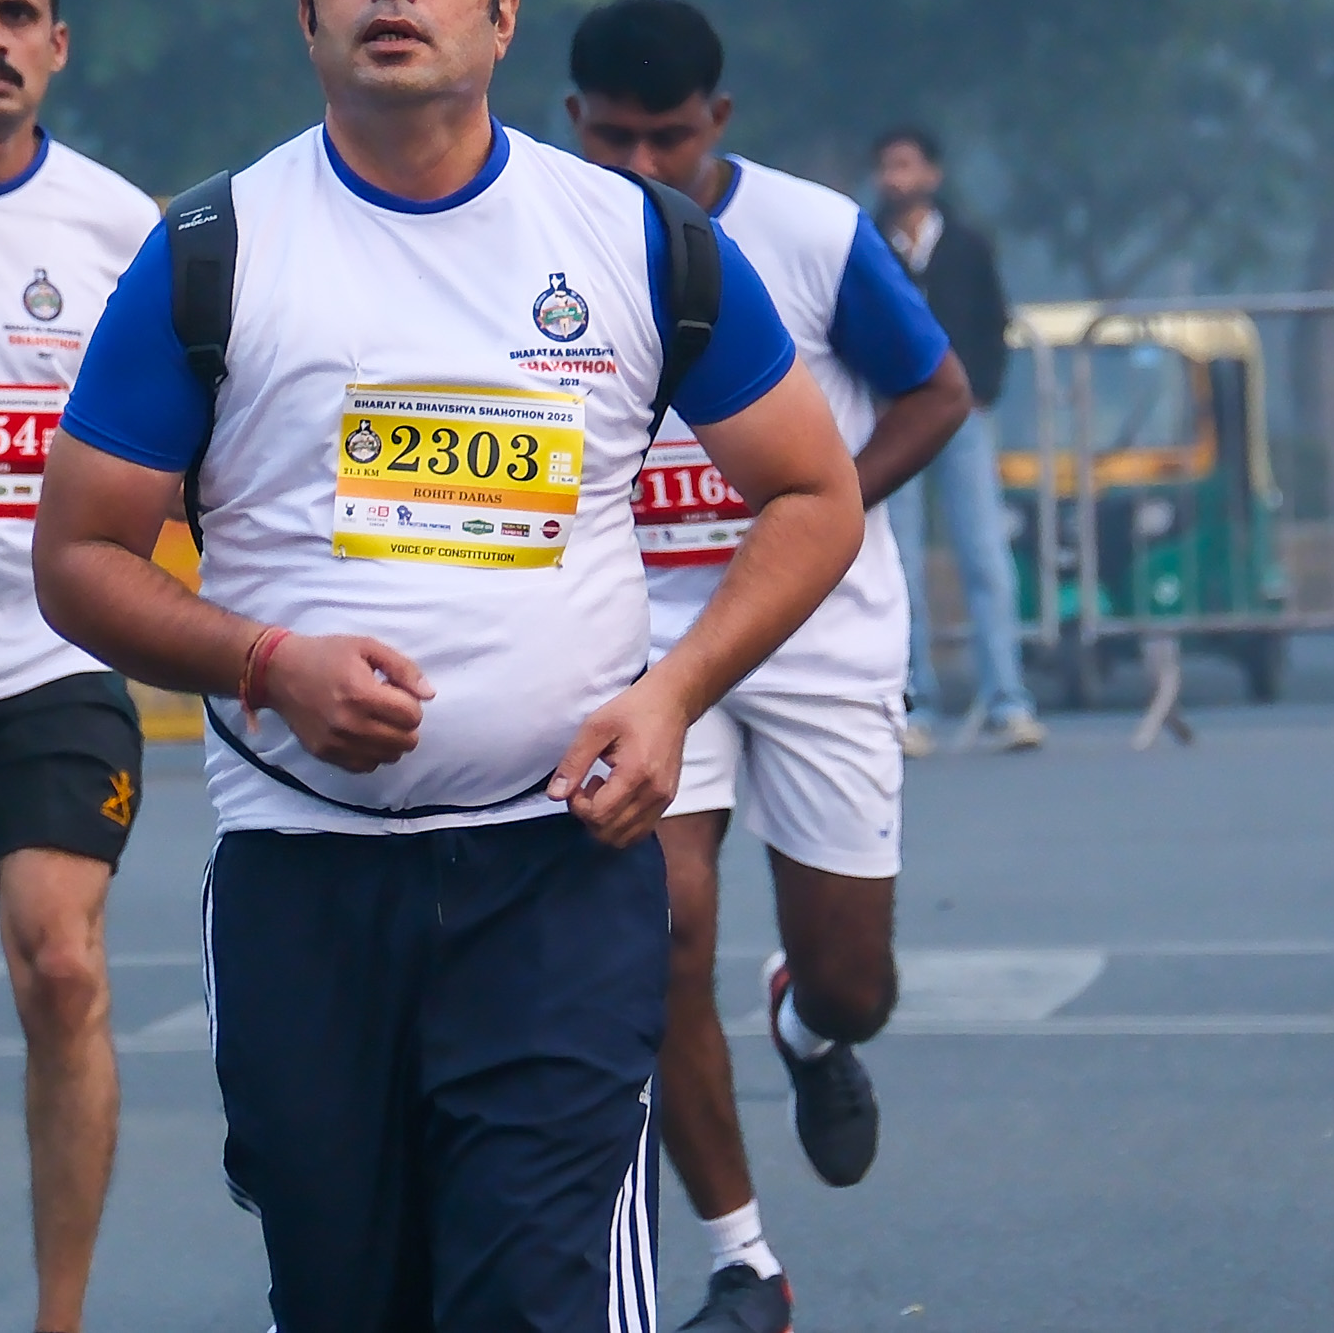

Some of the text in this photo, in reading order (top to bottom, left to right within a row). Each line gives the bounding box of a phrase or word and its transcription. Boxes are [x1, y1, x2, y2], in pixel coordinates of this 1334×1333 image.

[549, 348, 563, 357] KA
[354, 399, 397, 410] BHARAT
[398, 401, 413, 411] KA
[416, 402, 476, 415] BHAVISHYA
[547, 412, 573, 422] 2025
[387, 424, 540, 482] 2303
[363, 469, 380, 477] KM
[413, 487, 503, 504] ROHIT DABAS
[390, 543, 516, 563] VOICE OF CONSTITUTION
